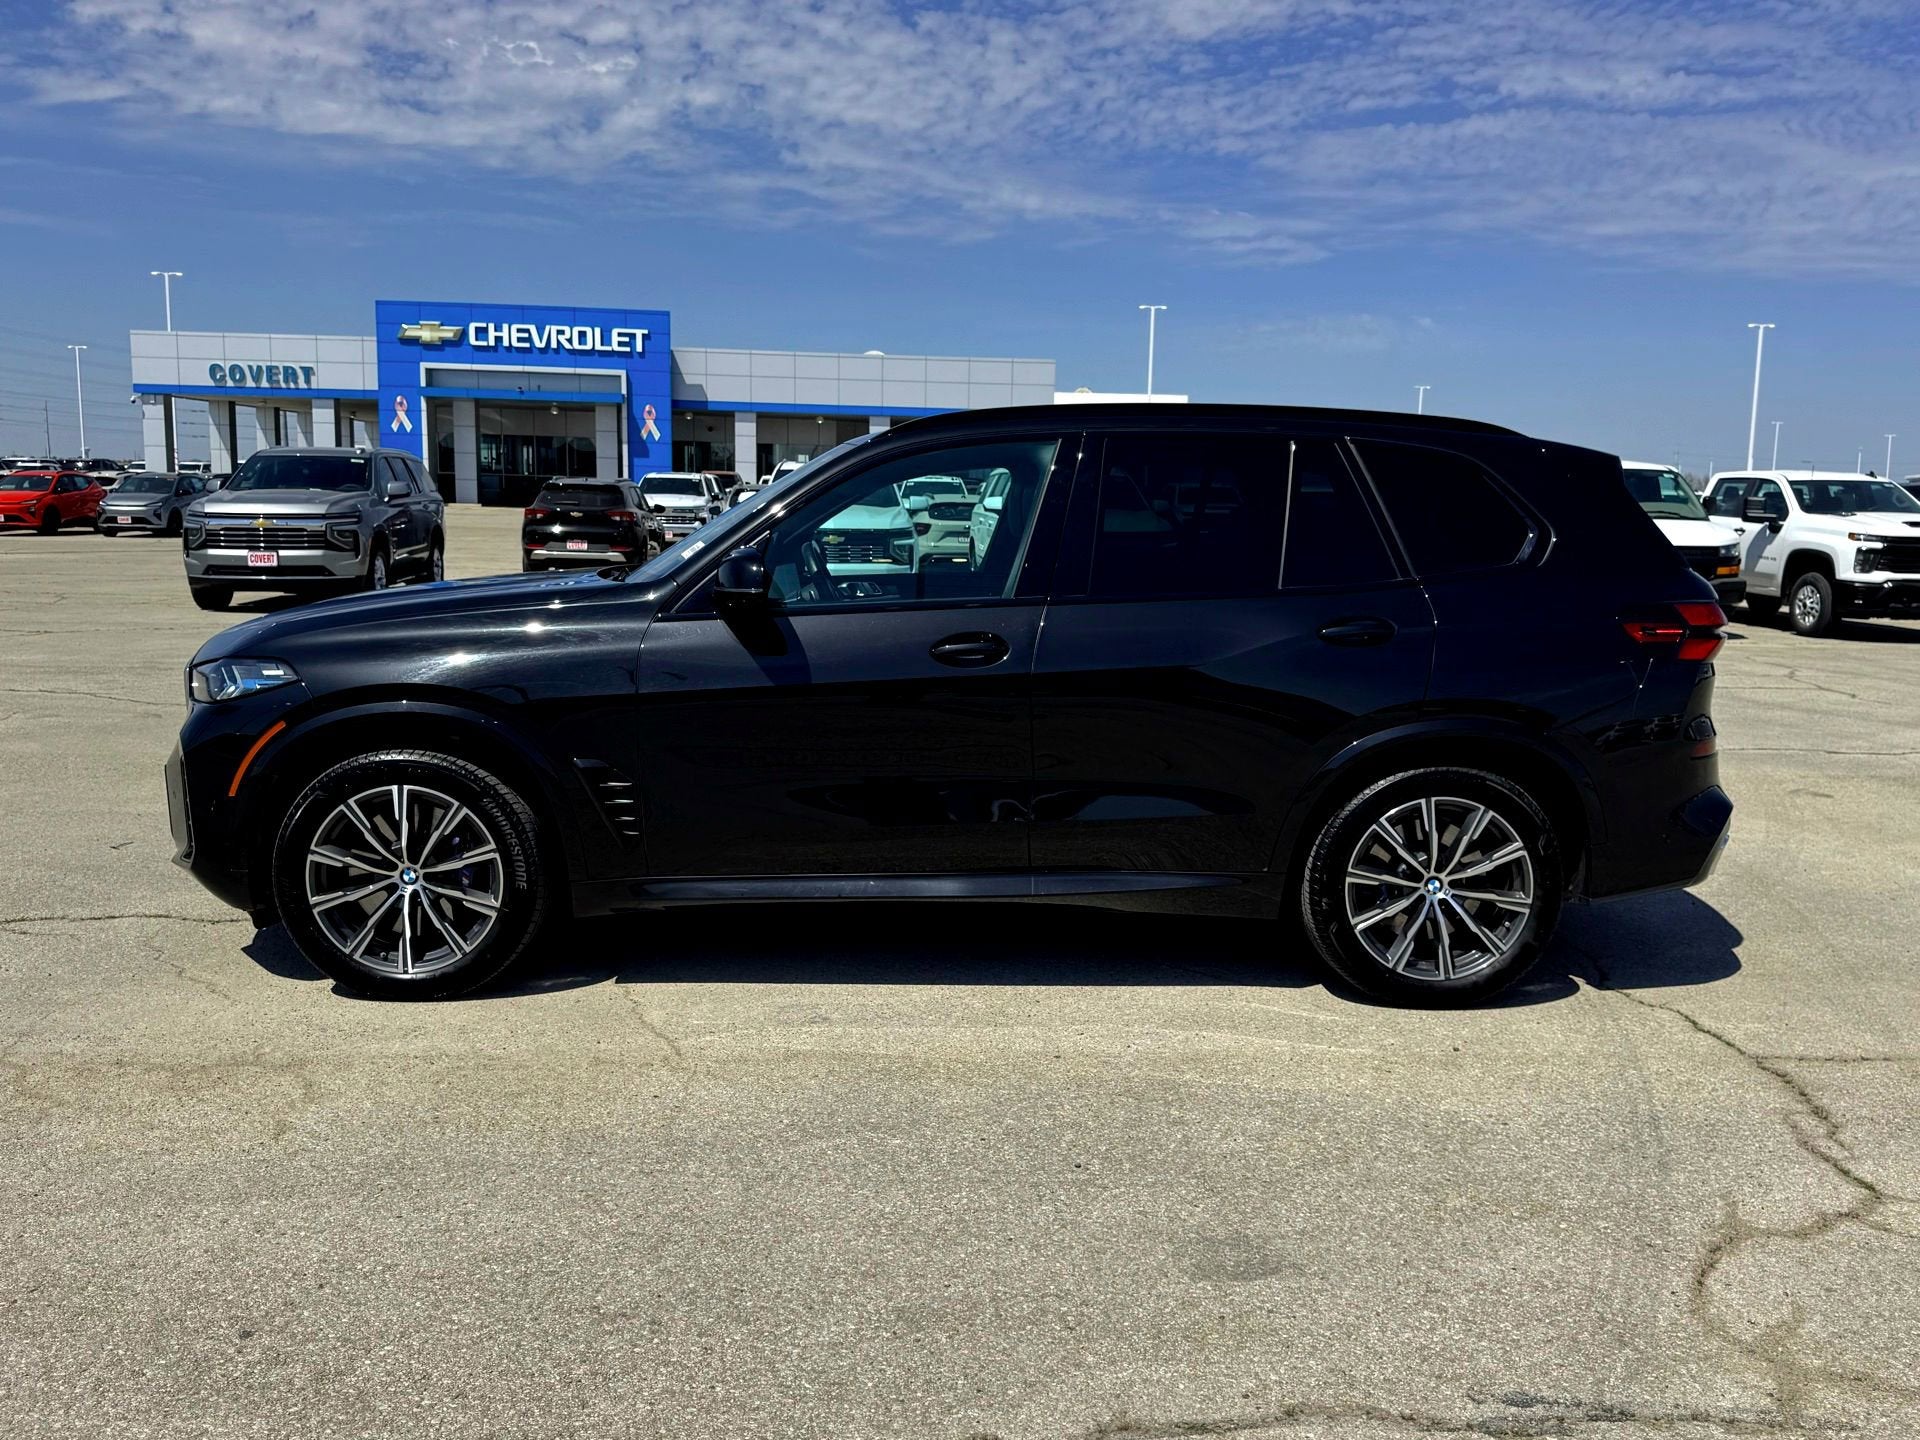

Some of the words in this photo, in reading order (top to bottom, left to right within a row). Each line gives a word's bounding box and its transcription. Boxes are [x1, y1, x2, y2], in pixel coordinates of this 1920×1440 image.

[468, 322, 648, 353] CHEVROLET
[209, 363, 315, 386] COVERT
[249, 554, 275, 564] COVERT
[481, 799, 527, 890] BRIDGESTONE
